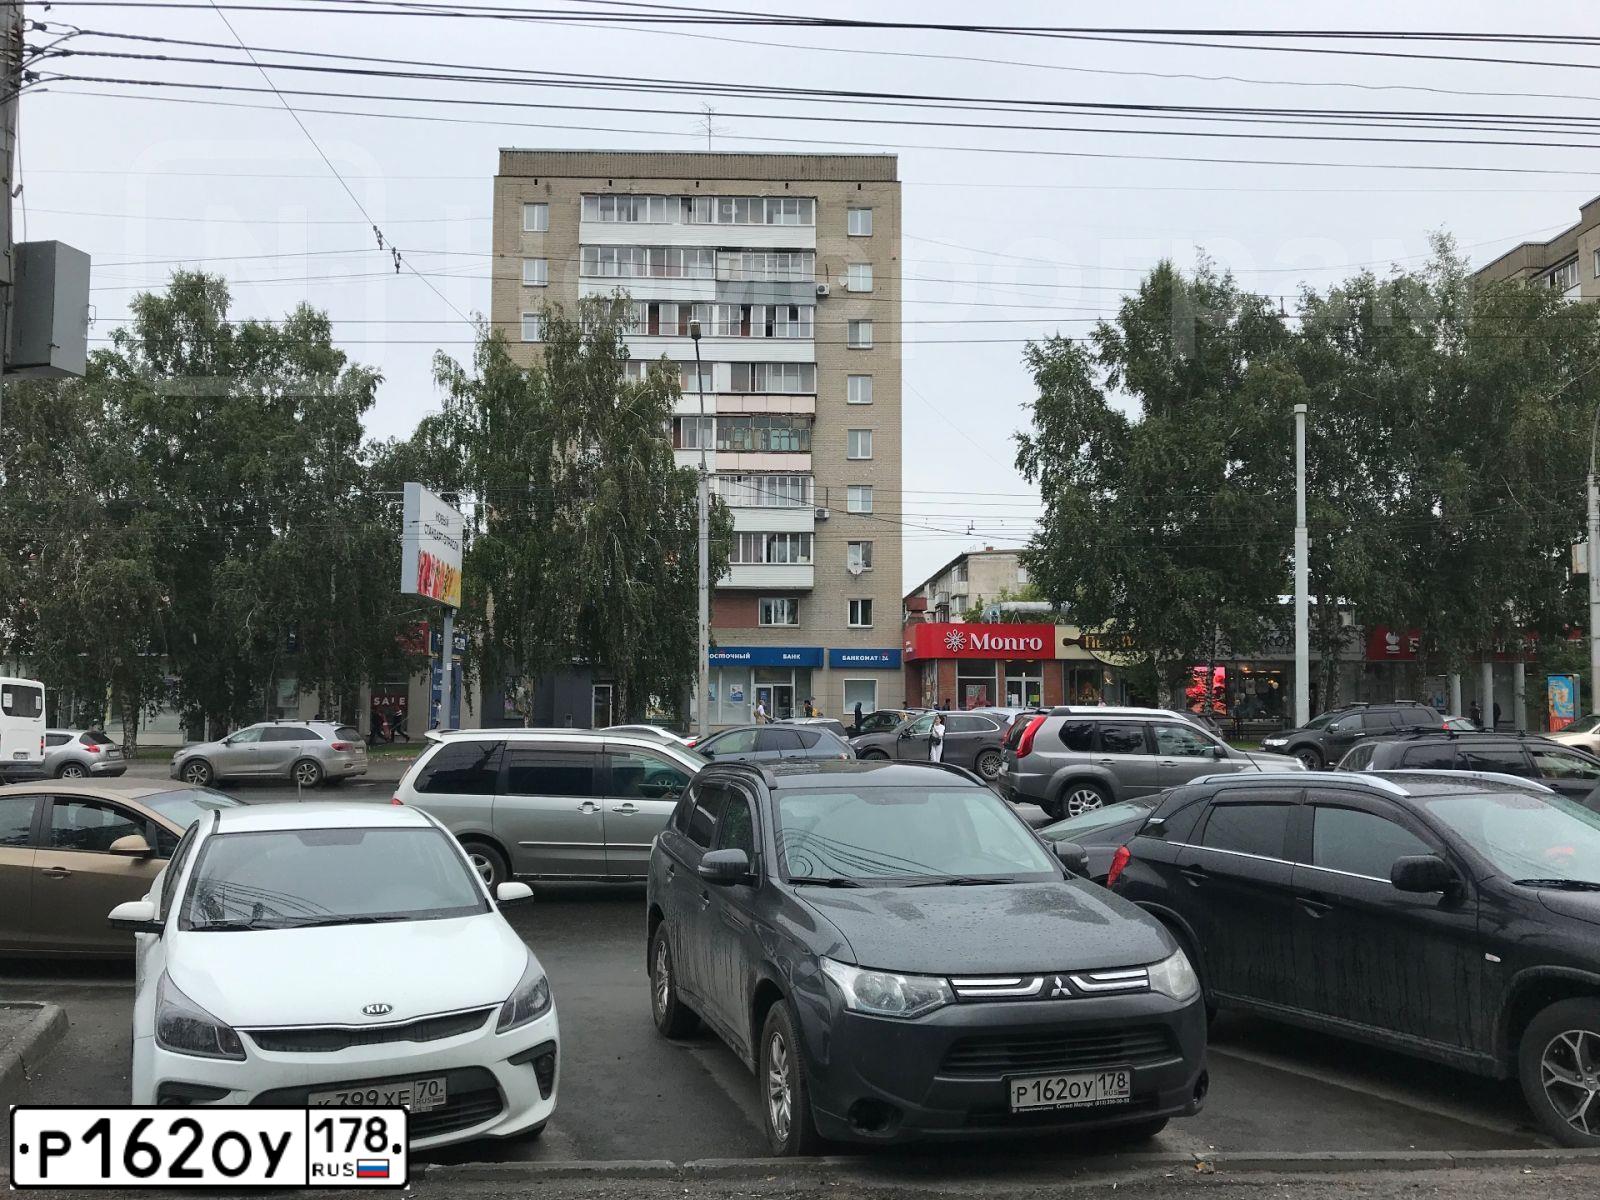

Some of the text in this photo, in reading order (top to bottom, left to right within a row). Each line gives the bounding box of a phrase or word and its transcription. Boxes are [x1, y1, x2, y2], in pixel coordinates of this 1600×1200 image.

[969, 632, 1043, 651] Monro
[709, 651, 801, 660] ОСТОЧНЫЙ БАНК
[841, 654, 878, 662] БАНКОМАТ
[366, 1004, 390, 1014] KIA
[1098, 1072, 1126, 1091] 178
[417, 1080, 439, 1098] 70
[1103, 1089, 1118, 1097] RUS
